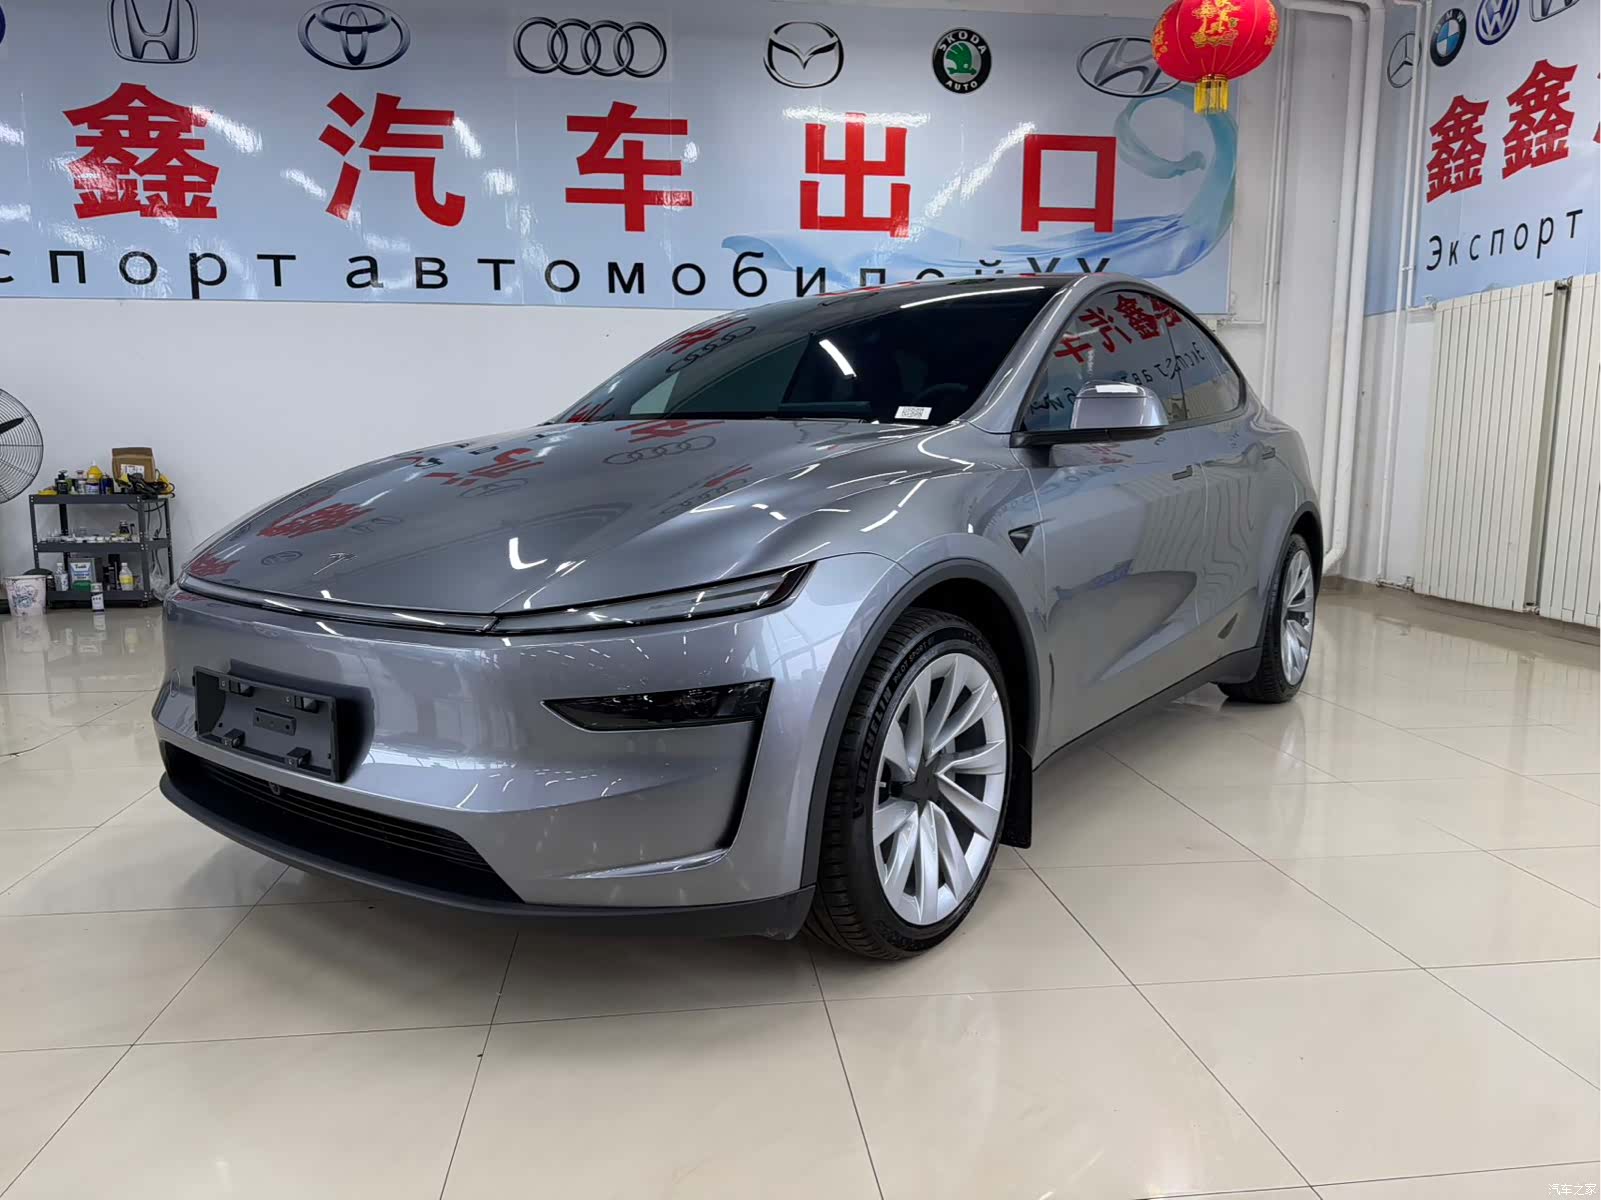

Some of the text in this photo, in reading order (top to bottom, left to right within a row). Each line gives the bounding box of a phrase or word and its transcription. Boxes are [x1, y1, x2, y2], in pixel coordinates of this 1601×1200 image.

[939, 31, 987, 54] SKODA
[945, 80, 978, 91] AUTO
[62, 83, 1117, 238] 鑫汽车出口
[1426, 59, 1600, 204] 鑫鑫
[1426, 209, 1583, 271] Экспорт
